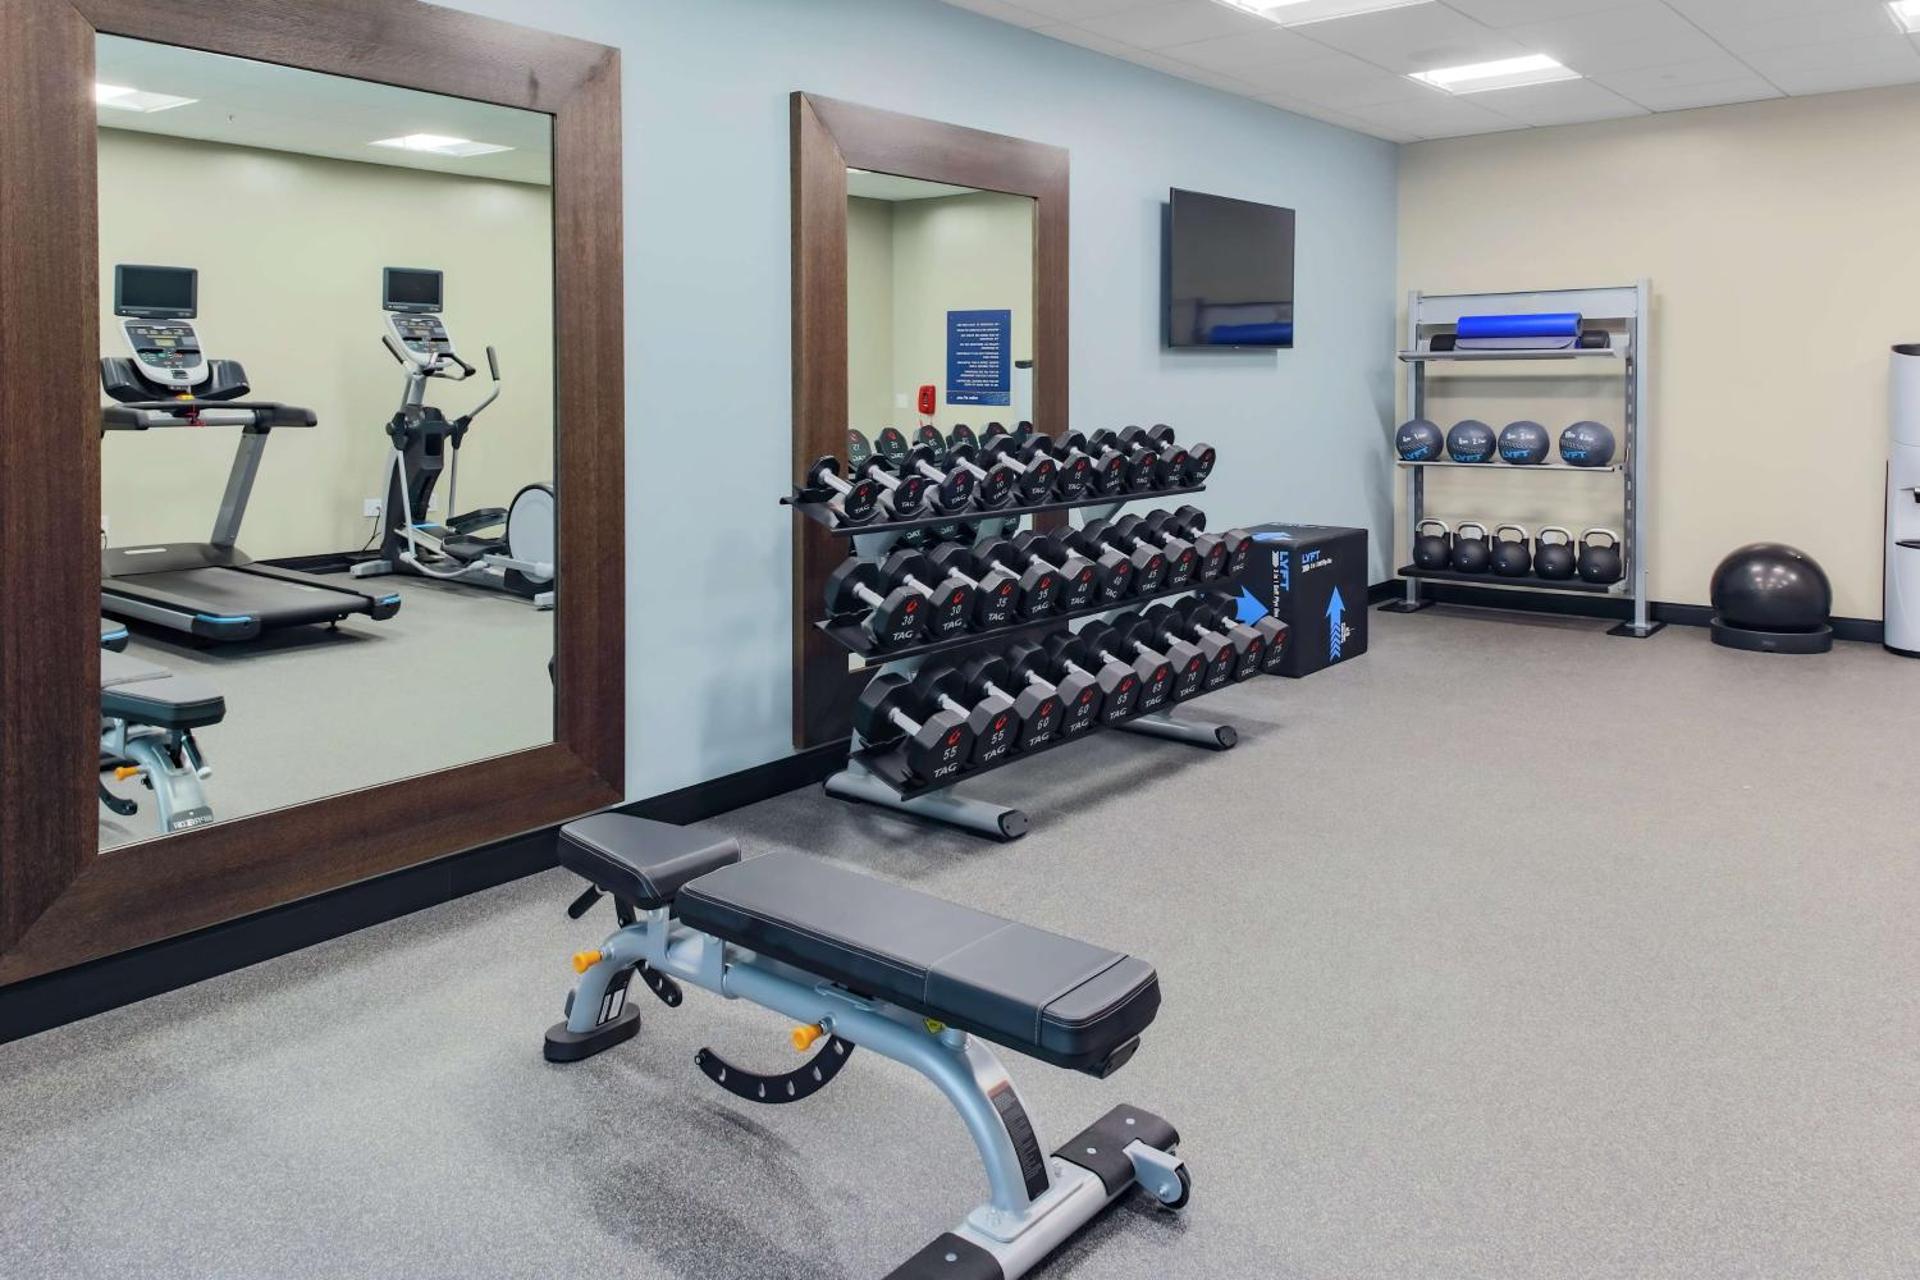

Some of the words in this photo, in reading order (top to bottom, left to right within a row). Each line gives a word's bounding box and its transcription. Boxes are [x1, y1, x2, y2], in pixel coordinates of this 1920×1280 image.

[951, 494, 967, 504] TAG
[1302, 549, 1320, 564] LYFT
[1279, 551, 1289, 592] LYFT
[1105, 587, 1119, 598] TAG
[1142, 582, 1157, 591] TAG
[1038, 588, 1048, 600] 35
[996, 597, 1008, 607] 35
[1070, 596, 1086, 605] TAG
[950, 604, 962, 616] 30
[1031, 601, 1049, 614] TAG
[901, 614, 914, 626] 30
[987, 612, 1005, 621] TAG
[942, 618, 963, 631] TAG
[893, 629, 914, 640] TAG
[1267, 656, 1281, 667] TAG
[1241, 665, 1255, 676] TAG
[1210, 674, 1225, 686] TAG
[1180, 684, 1196, 697] TAG
[1145, 695, 1162, 707] TAG
[1077, 703, 1089, 716] 60
[1109, 707, 1127, 720] TAG
[1036, 717, 1050, 730] 60
[1070, 718, 1089, 732] TAG
[990, 729, 1005, 744] 55
[1029, 731, 1050, 746] TAG
[943, 745, 958, 760] 55
[983, 744, 1006, 761] TAG
[934, 762, 959, 778] TAG
